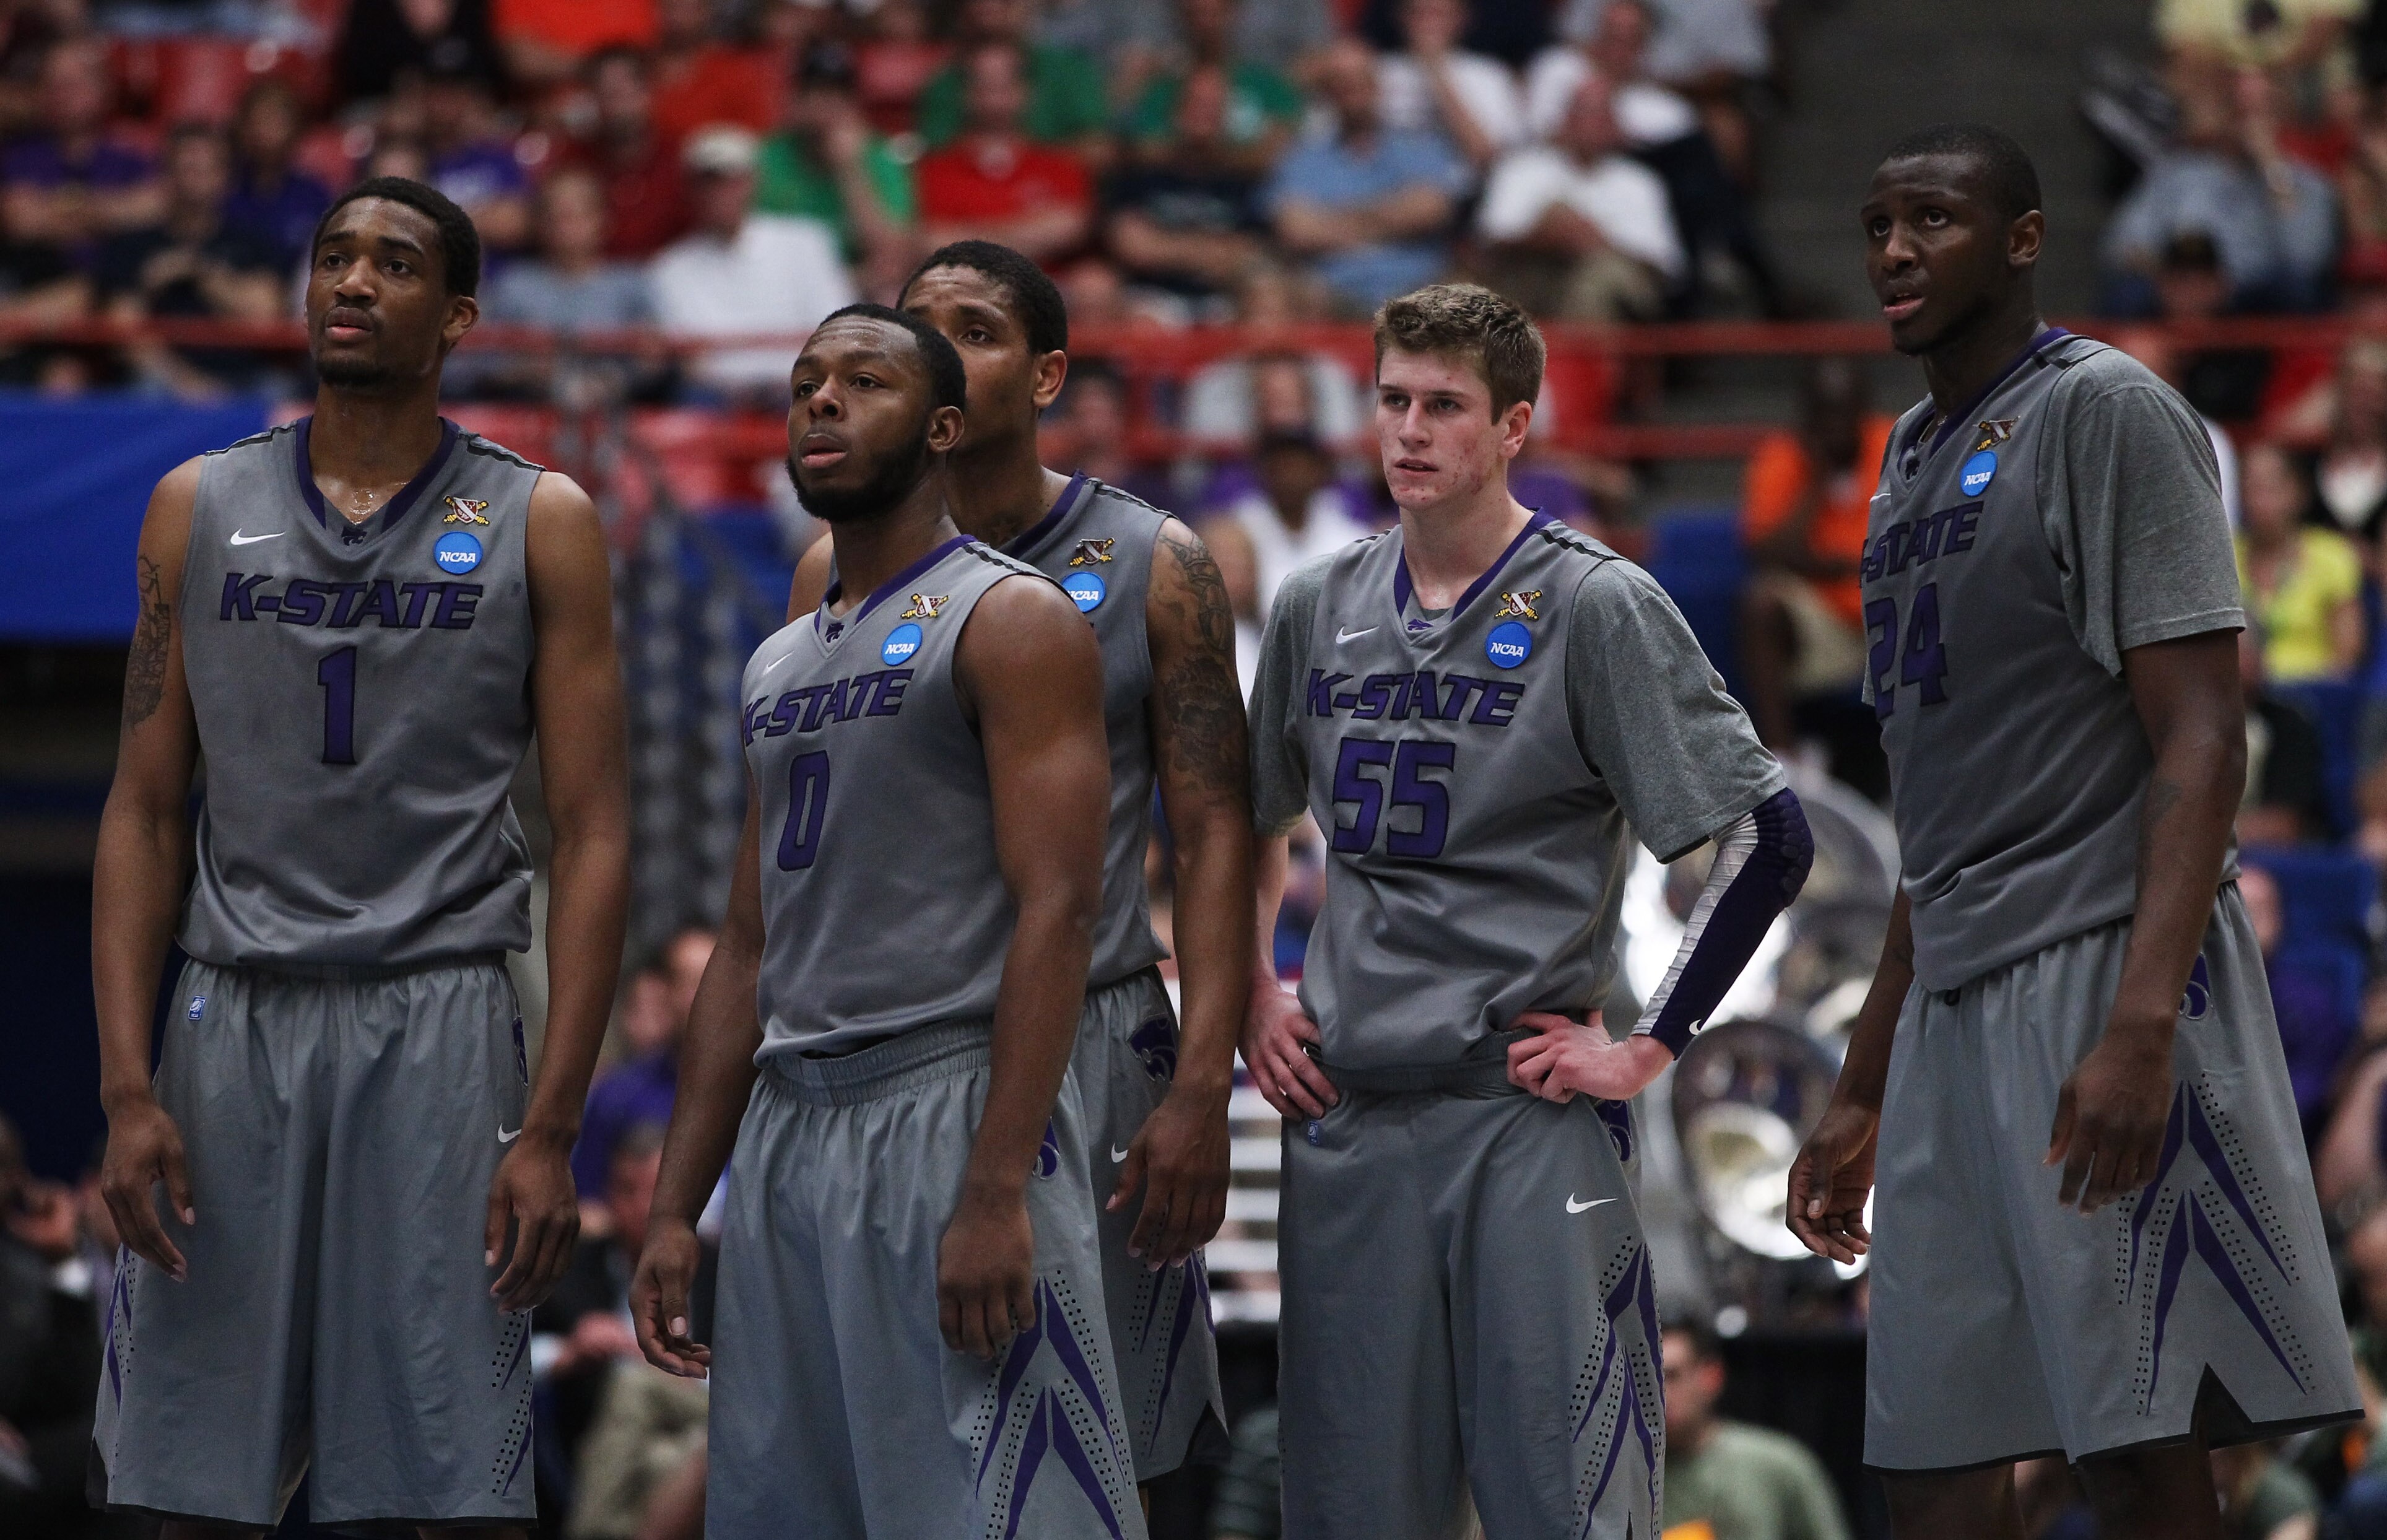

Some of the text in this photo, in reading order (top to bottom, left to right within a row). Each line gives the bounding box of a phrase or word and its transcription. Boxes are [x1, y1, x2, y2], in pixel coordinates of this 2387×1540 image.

[440, 551, 476, 563] NCAA
[219, 572, 483, 630] K-STATE
[885, 642, 915, 655] NCAA
[1490, 642, 1524, 658] NCAA
[1865, 582, 1948, 722] 24
[317, 645, 357, 765] 1
[743, 669, 914, 747] K-STATE
[1307, 668, 1525, 727] K-STATE
[777, 750, 830, 872] 0
[1331, 737, 1456, 858] 55
